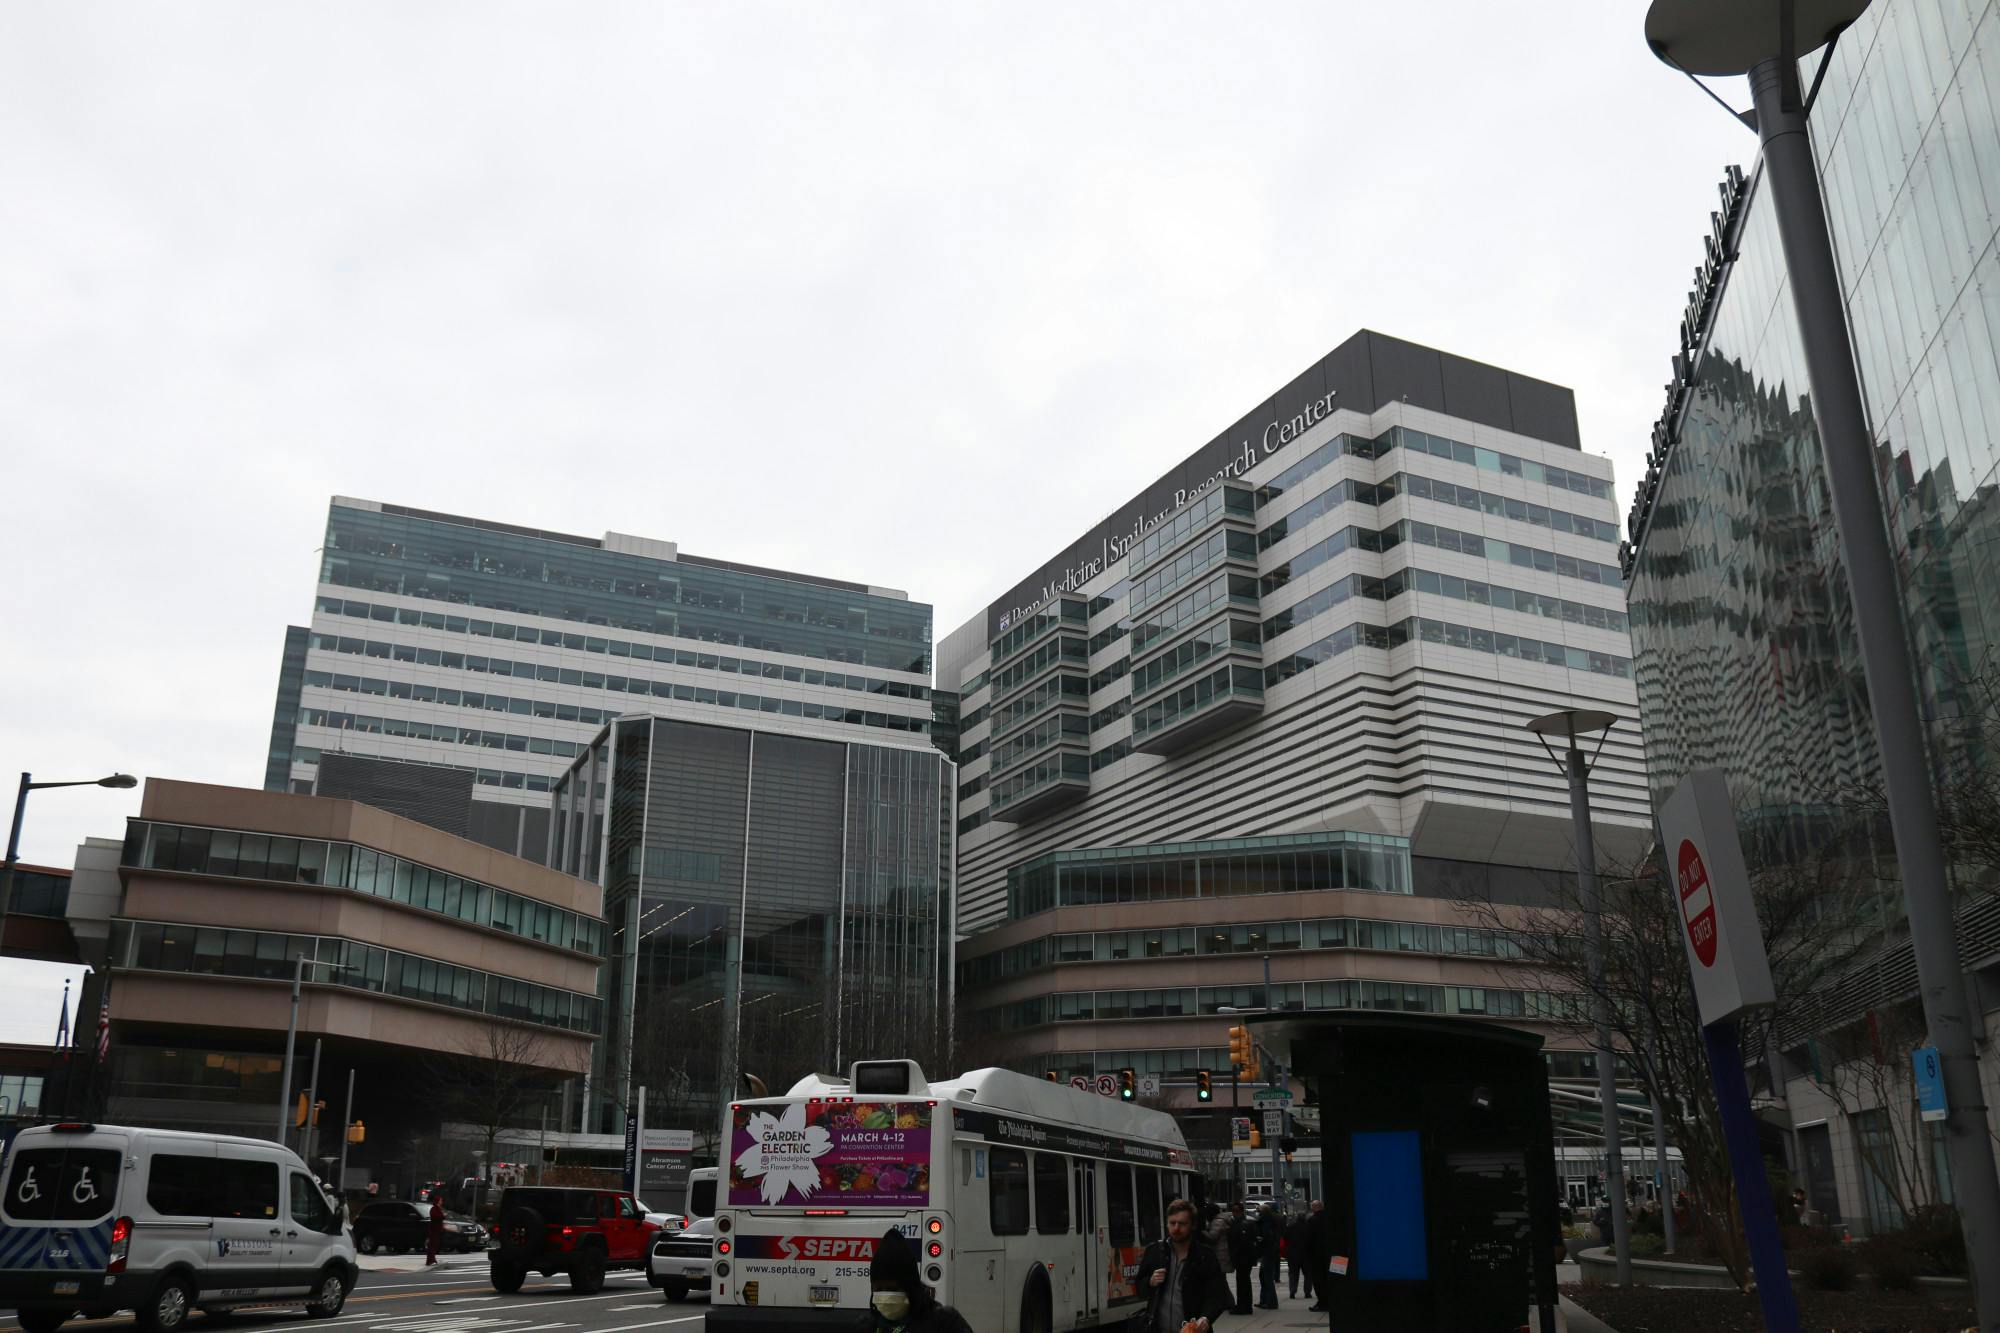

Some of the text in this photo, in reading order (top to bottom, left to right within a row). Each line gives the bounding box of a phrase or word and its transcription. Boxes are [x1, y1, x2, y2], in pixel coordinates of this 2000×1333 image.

[1042, 557, 1101, 600] Medicine
[1263, 390, 1337, 454] Center
[1679, 858, 1701, 893] DO NOT
[1693, 917, 1713, 945] ENTER
[762, 1131, 806, 1142] GARDEN
[998, 1119, 1007, 1135] The
[1007, 1120, 1031, 1142] Philadelphia
[841, 1132, 905, 1142] MARCH 4-12
[761, 1143, 811, 1154] ELECTRIC
[770, 1155, 810, 1164] Philadelphia
[231, 1239, 273, 1249] KEYSTONE
[803, 1239, 874, 1258] SEPTA
[745, 1264, 816, 1276] www.septa.org
